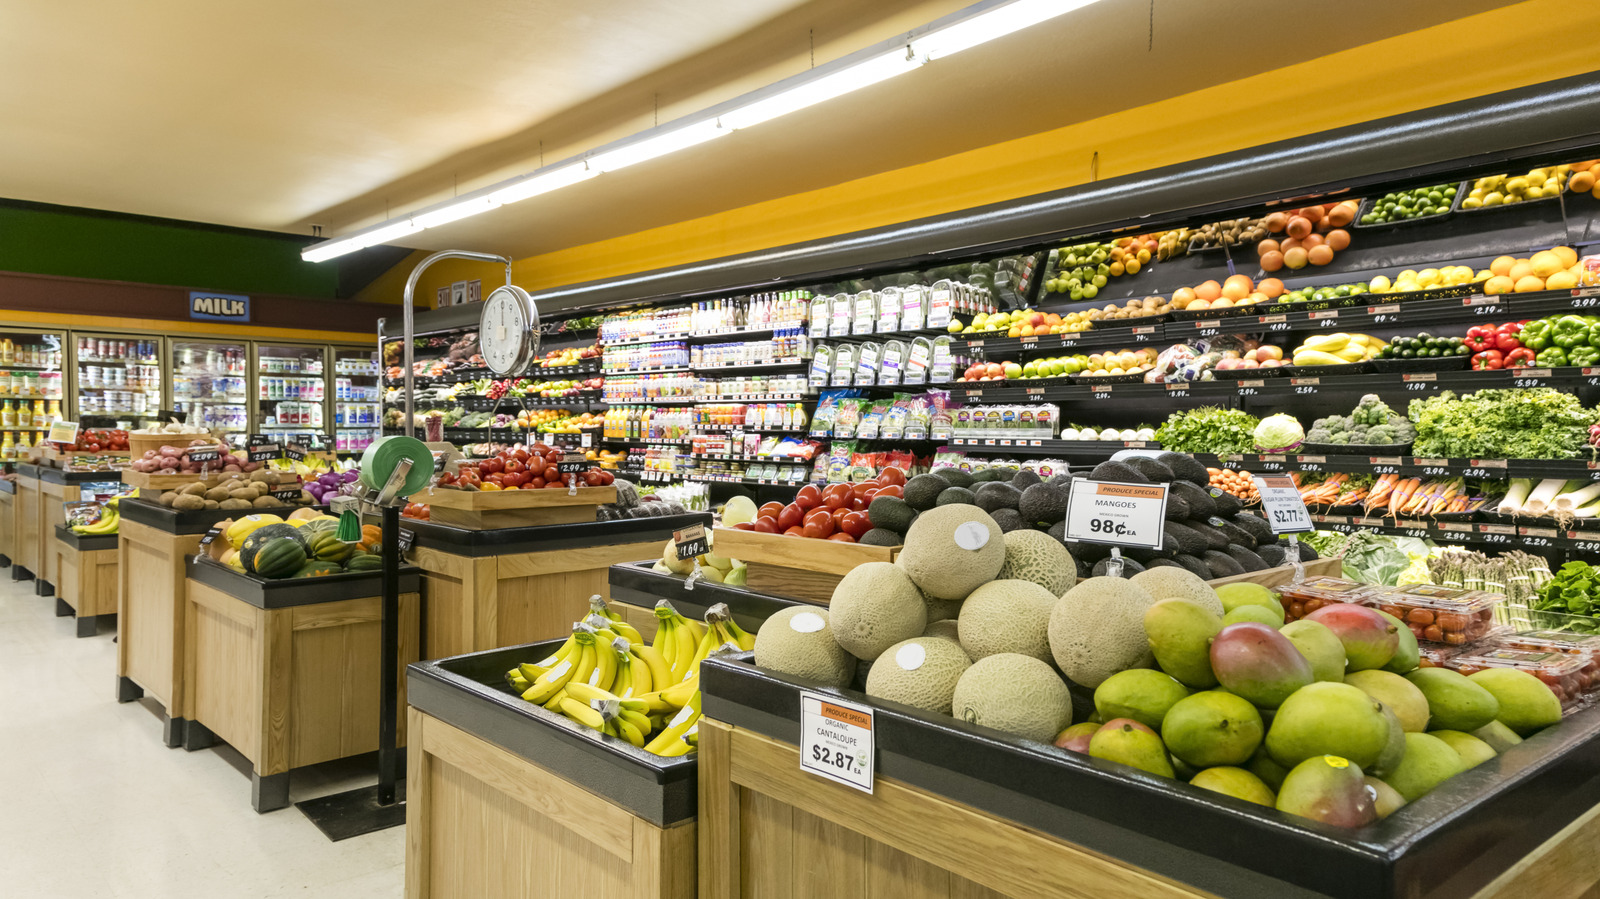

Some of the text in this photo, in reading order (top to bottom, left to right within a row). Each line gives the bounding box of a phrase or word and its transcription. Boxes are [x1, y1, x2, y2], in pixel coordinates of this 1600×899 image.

[194, 298, 245, 315] MILK
[487, 321, 492, 330] 2
[487, 338, 491, 347] 3
[1095, 500, 1137, 508] MANGOES
[1274, 509, 1298, 524] $2.77
[1090, 519, 1126, 537] 98¢
[826, 707, 867, 724] PRODUCE SPECIAL
[825, 719, 848, 731] ORGANIC
[817, 728, 857, 746] CANTALOUPE
[813, 744, 854, 771] $2.87
